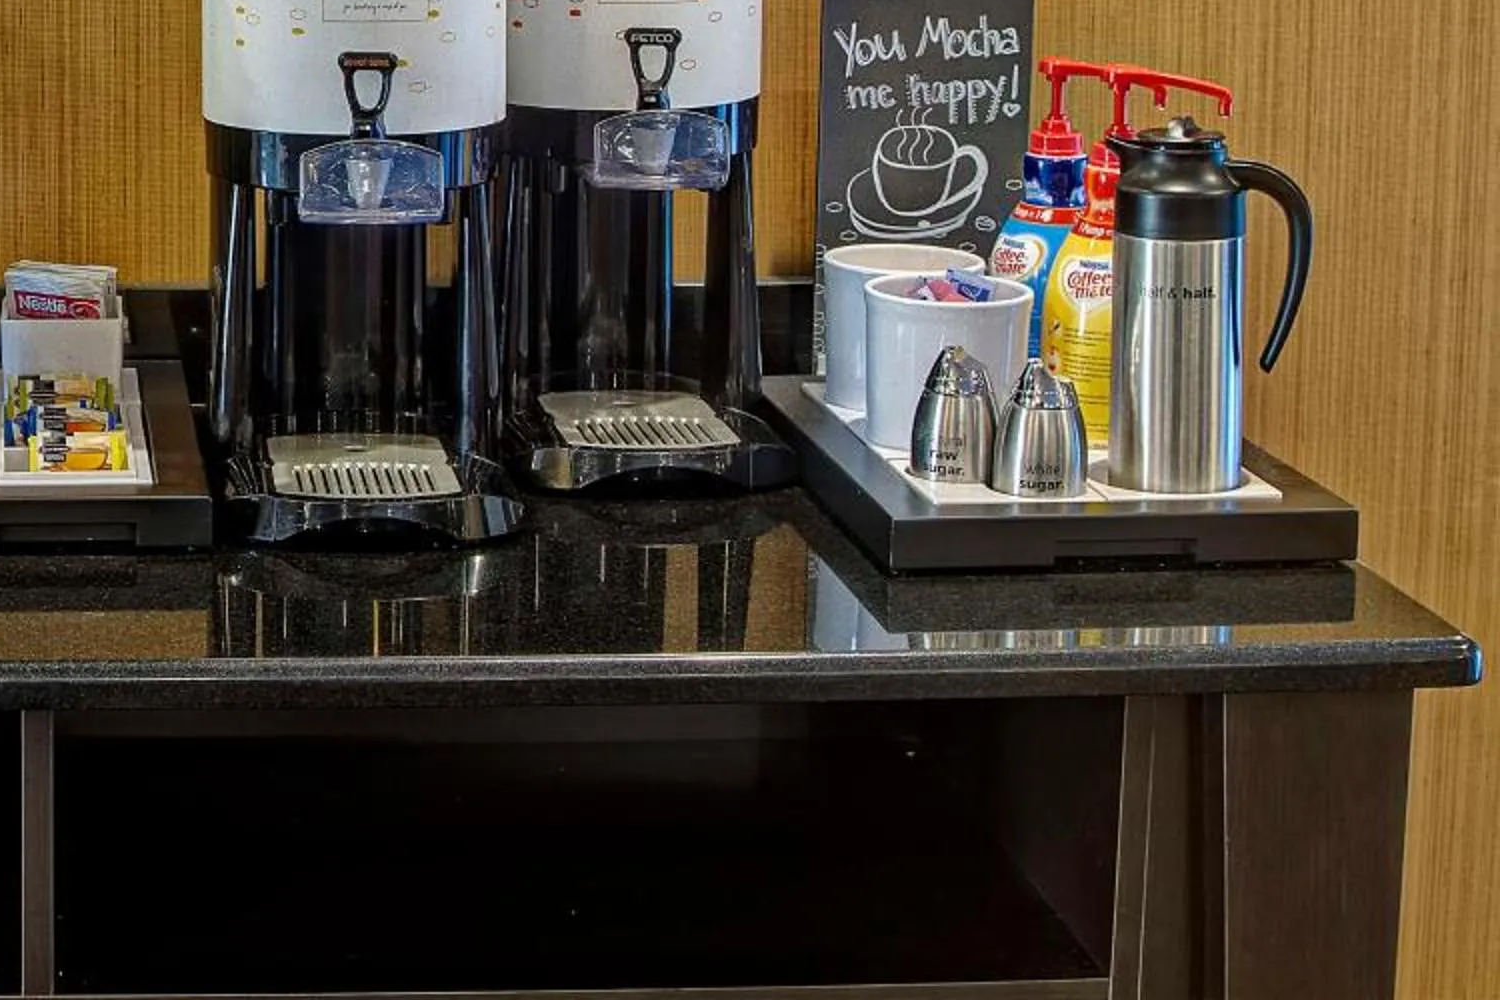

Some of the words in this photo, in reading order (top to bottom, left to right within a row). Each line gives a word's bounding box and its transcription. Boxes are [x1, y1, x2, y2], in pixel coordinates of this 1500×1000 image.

[833, 21, 907, 78] You
[915, 13, 1020, 61] Mocha
[844, 83, 896, 110] me
[907, 64, 1021, 125] happy!
[1167, 287, 1178, 299] &
[929, 449, 959, 461] raw
[1019, 479, 1065, 492] sugar.
